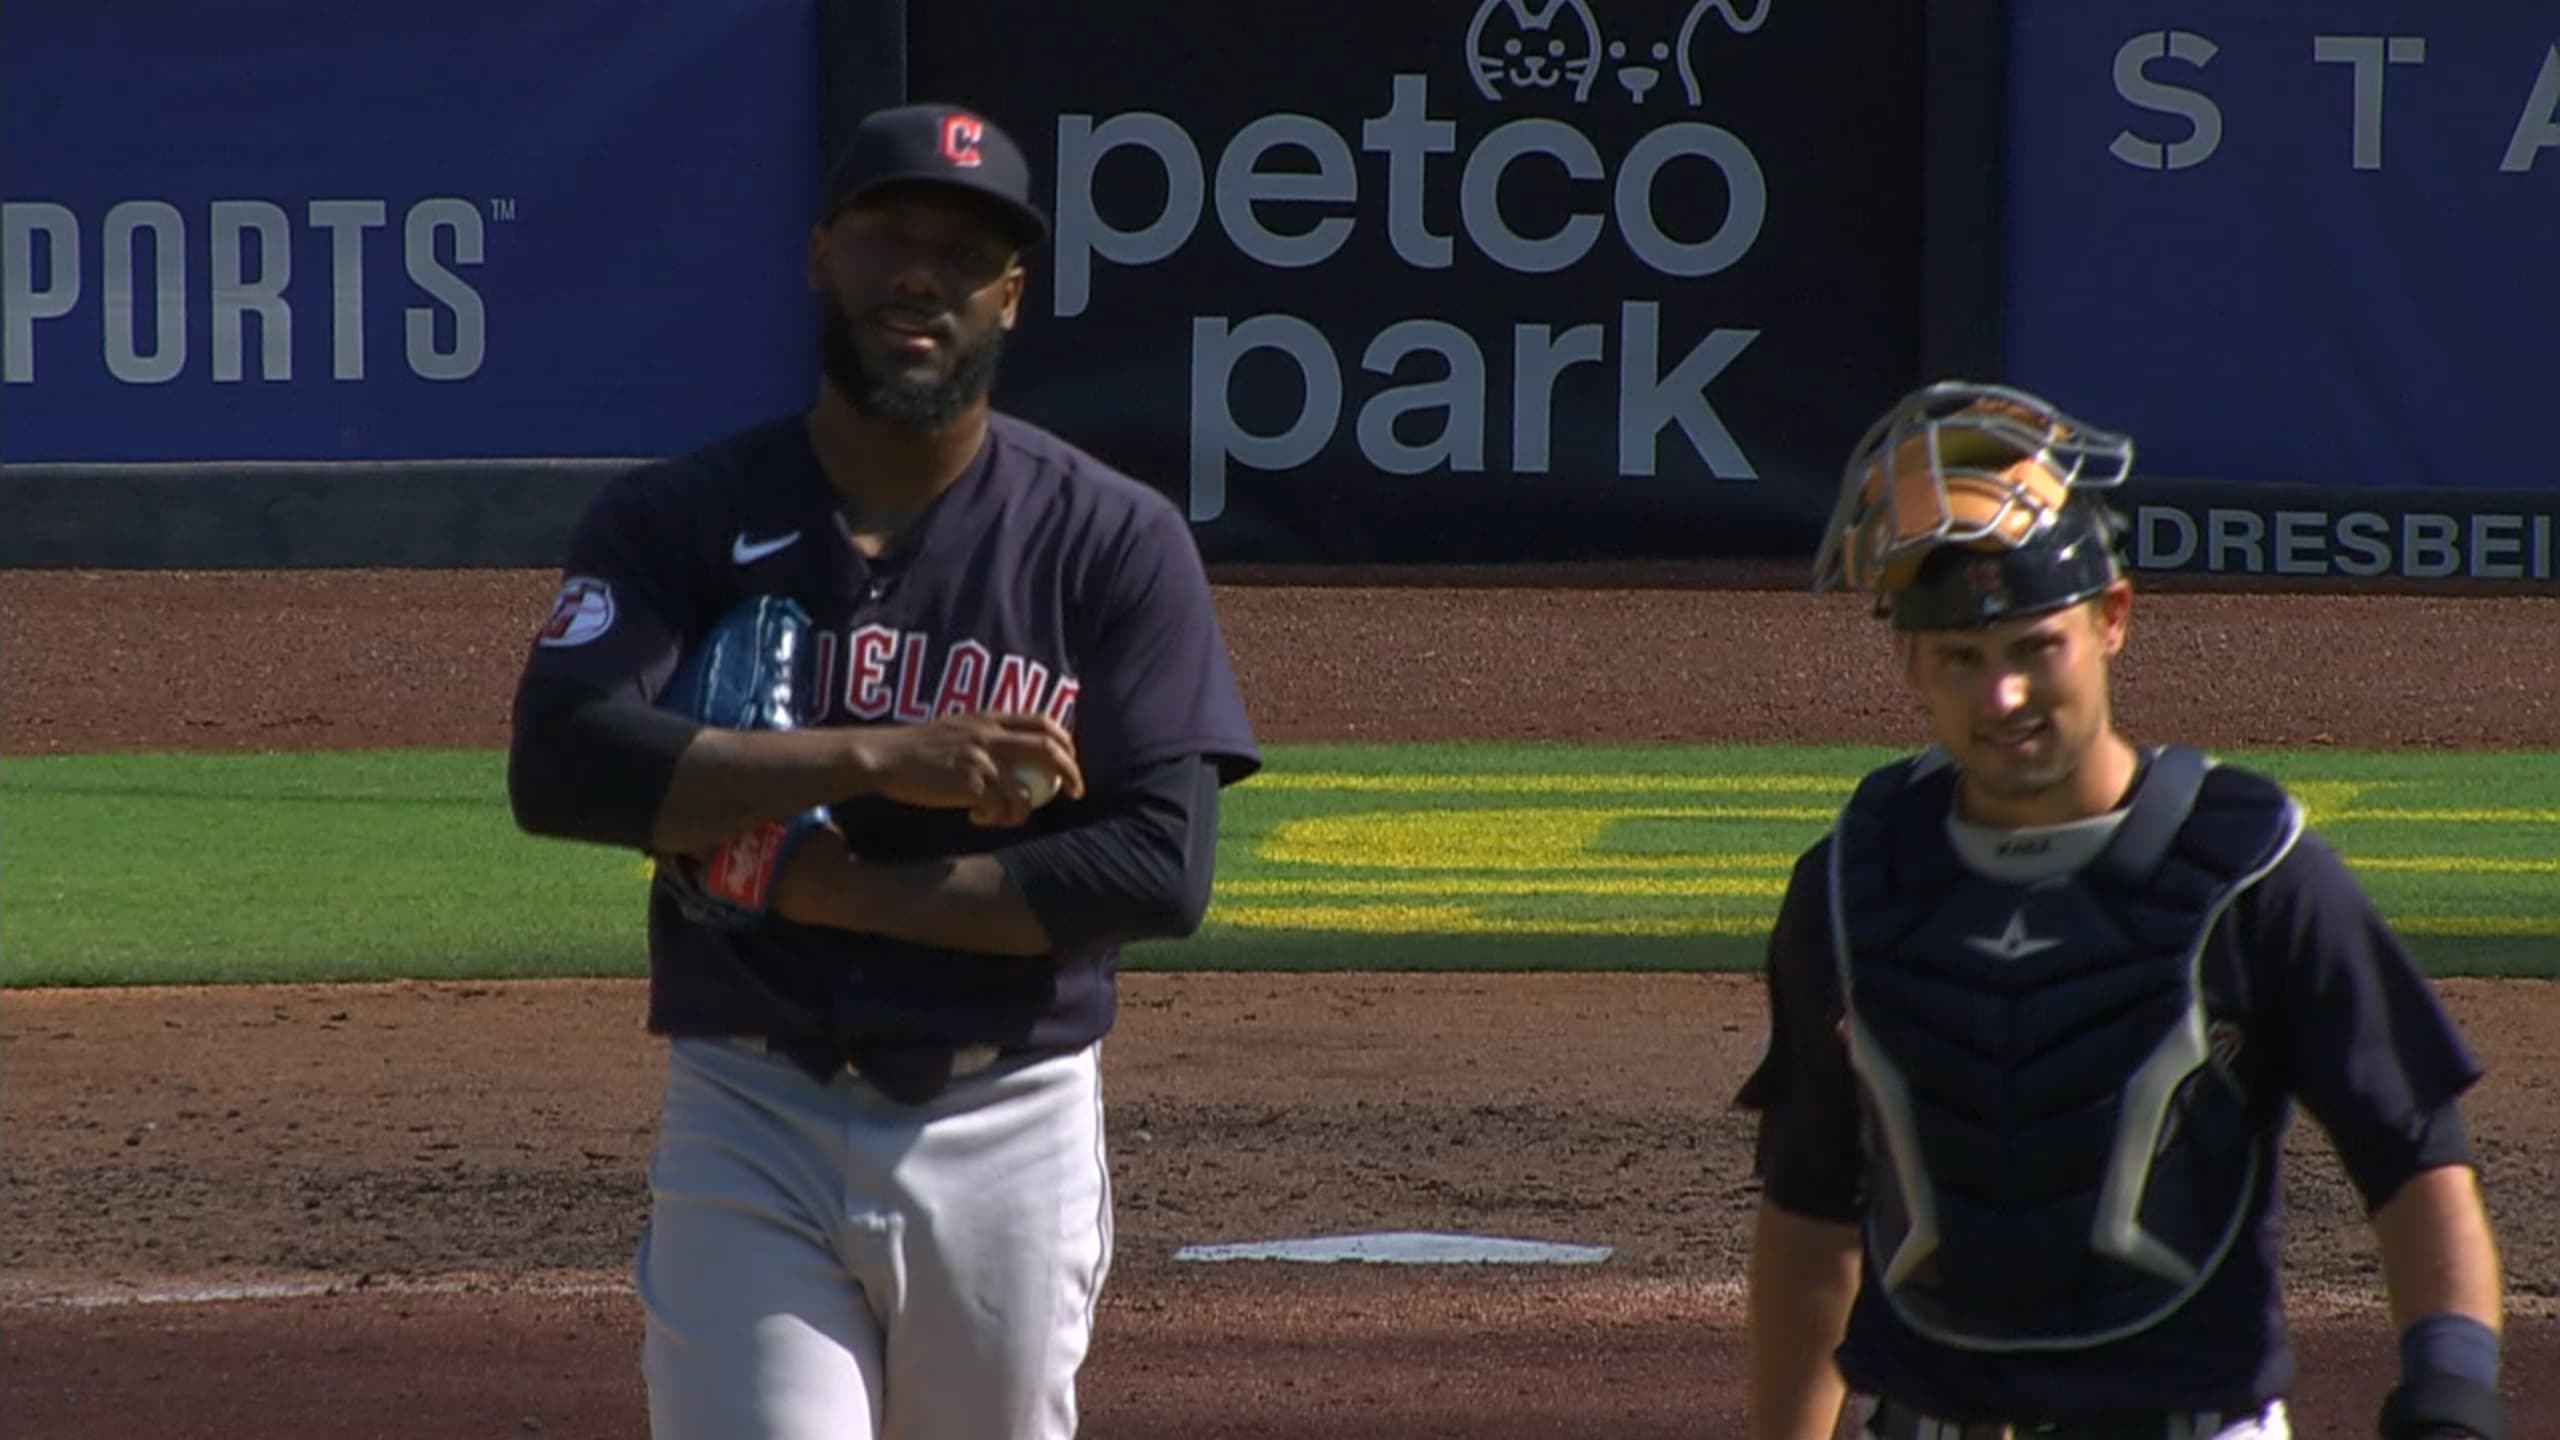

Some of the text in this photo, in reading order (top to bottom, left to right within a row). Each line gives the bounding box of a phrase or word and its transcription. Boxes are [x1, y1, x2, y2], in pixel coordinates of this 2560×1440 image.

[943, 112, 982, 168] C
[1053, 74, 1767, 316] petco
[2, 197, 486, 383] PORTS
[1189, 301, 1761, 522] park
[2120, 505, 2551, 579] DRESBEI
